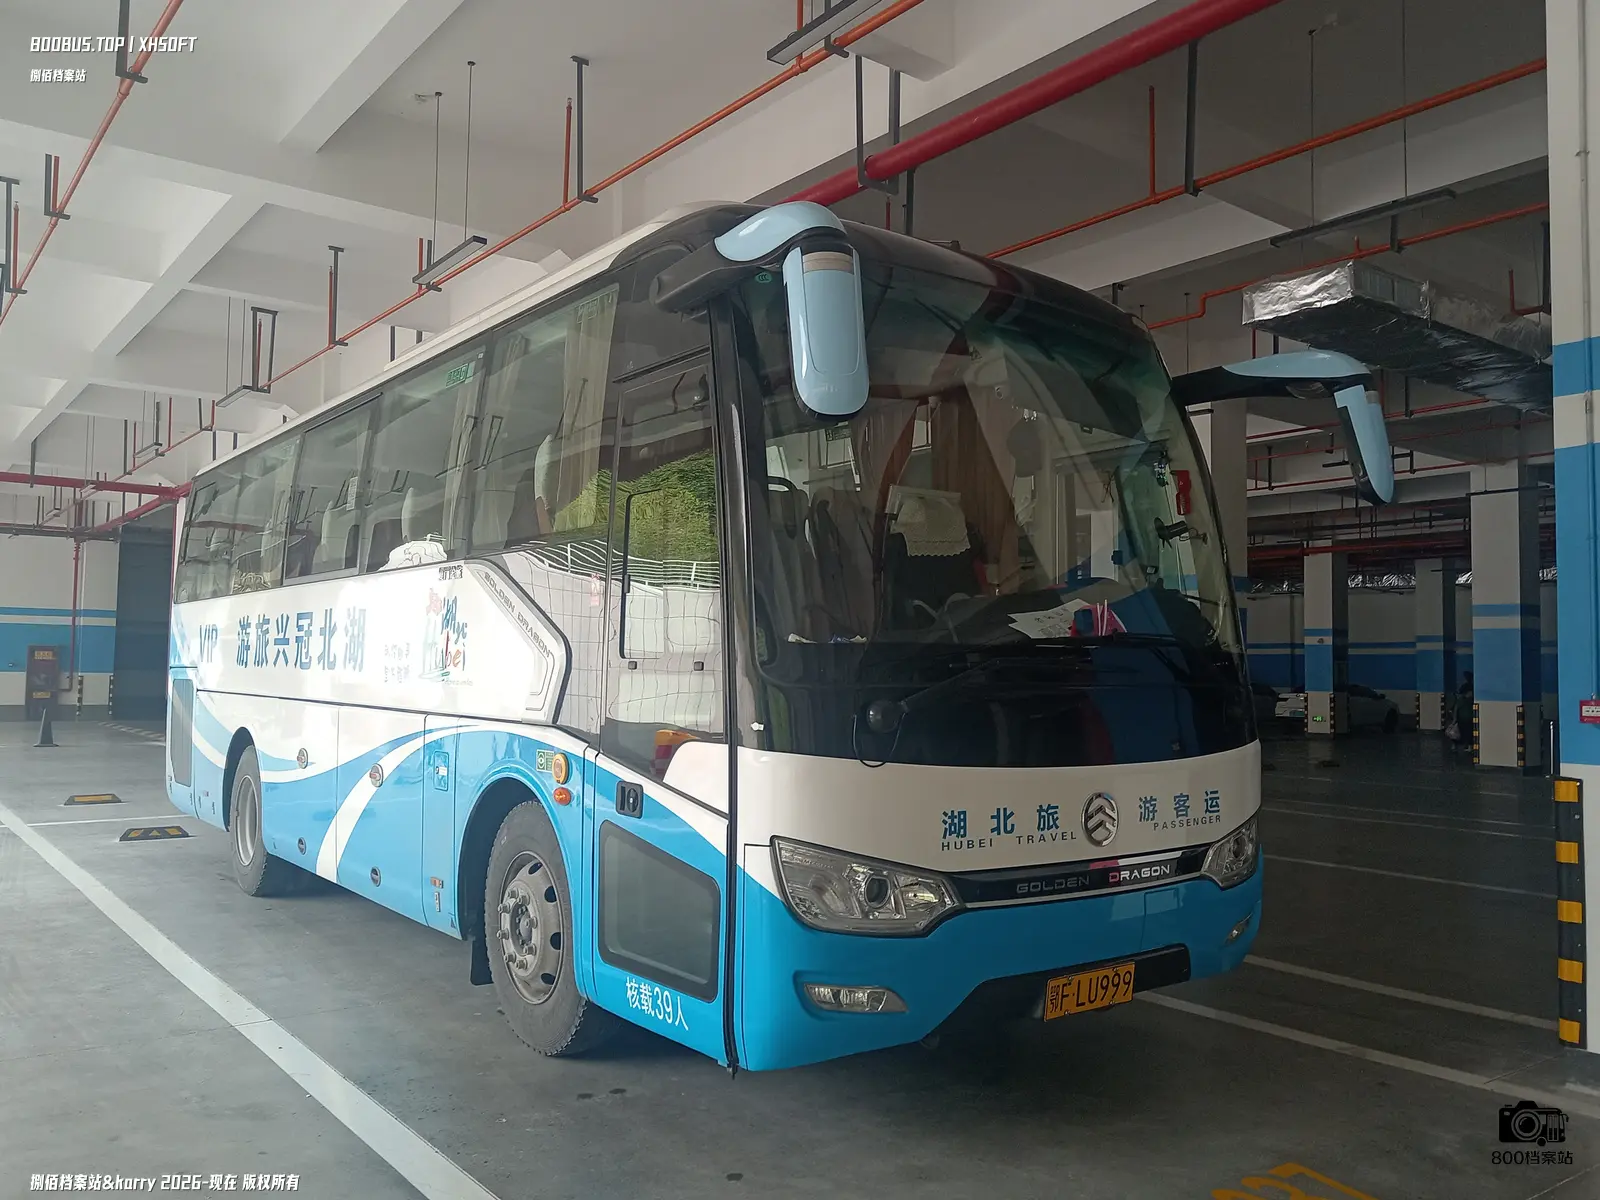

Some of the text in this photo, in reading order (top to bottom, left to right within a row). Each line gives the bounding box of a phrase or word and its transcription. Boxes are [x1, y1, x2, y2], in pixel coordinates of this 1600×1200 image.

[199, 623, 219, 664] VIP
[941, 814, 1221, 851] HUBEI TRAVEL PASSENGER
[1016, 864, 1171, 894] GOLDEN DRAGON
[625, 976, 689, 1031] 核载39人
